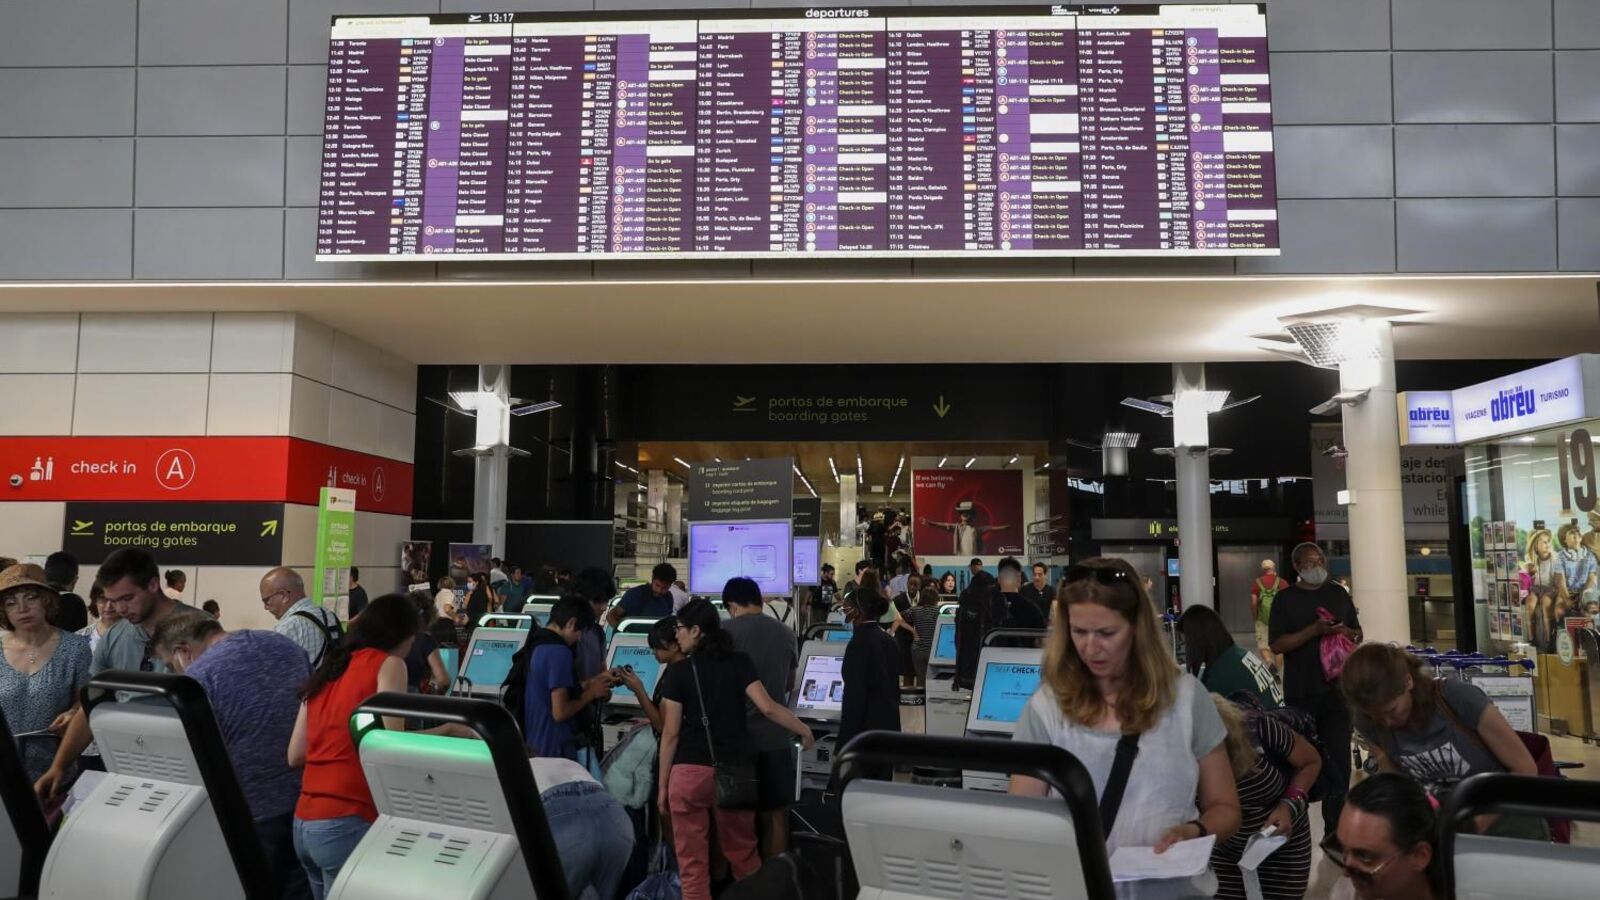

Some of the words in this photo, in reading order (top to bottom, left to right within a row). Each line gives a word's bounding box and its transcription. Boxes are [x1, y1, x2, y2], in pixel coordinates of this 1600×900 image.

[488, 14, 514, 22] 13:17
[805, 7, 869, 19] departures
[769, 397, 813, 409] portas
[817, 396, 834, 407] de
[837, 396, 908, 410] embarque
[1465, 408, 1487, 420] VIAGENS
[1491, 389, 1536, 422] abreu
[1540, 388, 1569, 402] TURISMO
[768, 410, 827, 423] boarding
[831, 411, 868, 423] gates
[1409, 407, 1449, 421] abreu
[71, 460, 118, 474] check
[123, 461, 137, 474] in
[166, 457, 184, 479] A
[1402, 458, 1422, 470] aje
[342, 473, 359, 485] check
[360, 476, 367, 486] in
[376, 476, 383, 493] A
[1413, 504, 1445, 515] while
[105, 521, 149, 534] portas
[151, 520, 166, 532] de
[170, 521, 236, 534] embarque
[104, 535, 158, 547] boarding
[161, 536, 197, 547] gates
